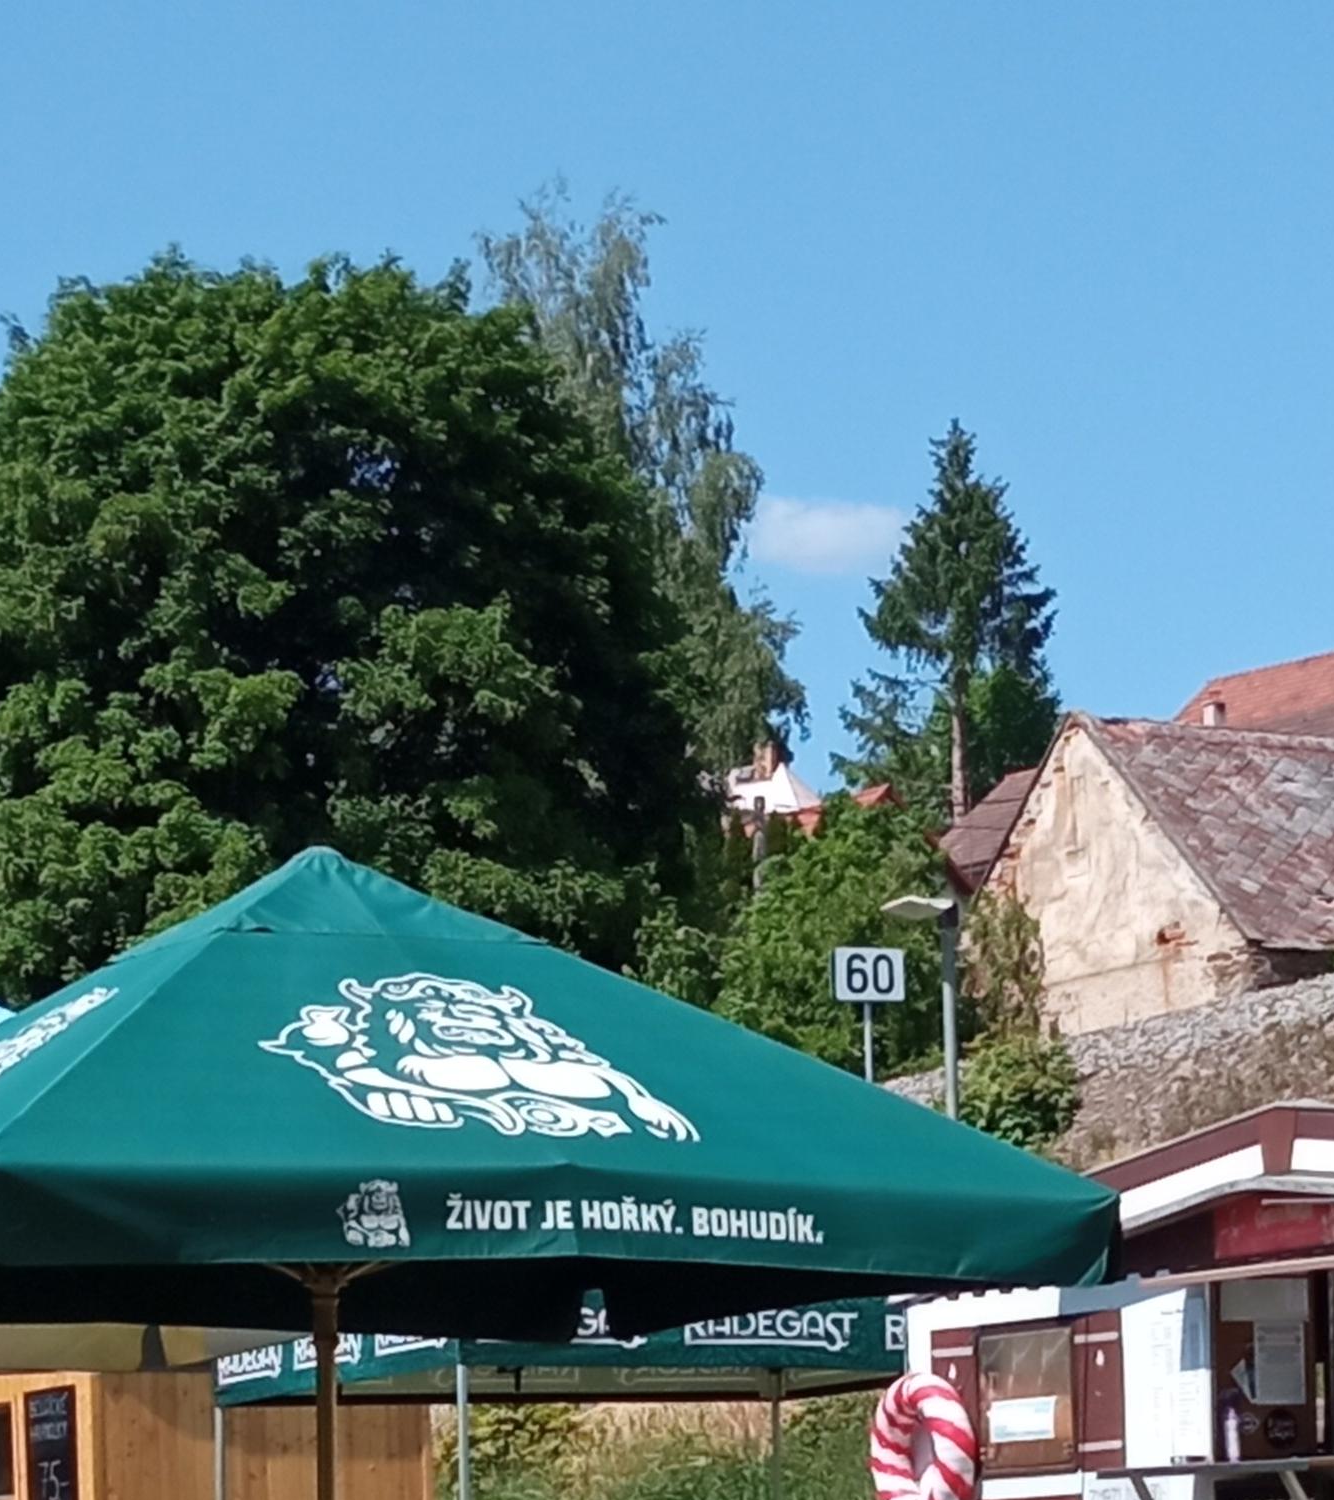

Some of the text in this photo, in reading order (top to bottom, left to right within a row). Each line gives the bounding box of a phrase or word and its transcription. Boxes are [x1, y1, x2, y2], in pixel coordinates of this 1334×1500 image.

[847, 953, 894, 994] 60
[446, 1193, 824, 1244] ŽIVOT JE HOŘKÝ. BOHUDÍK.
[684, 1309, 858, 1351] RADEGAST
